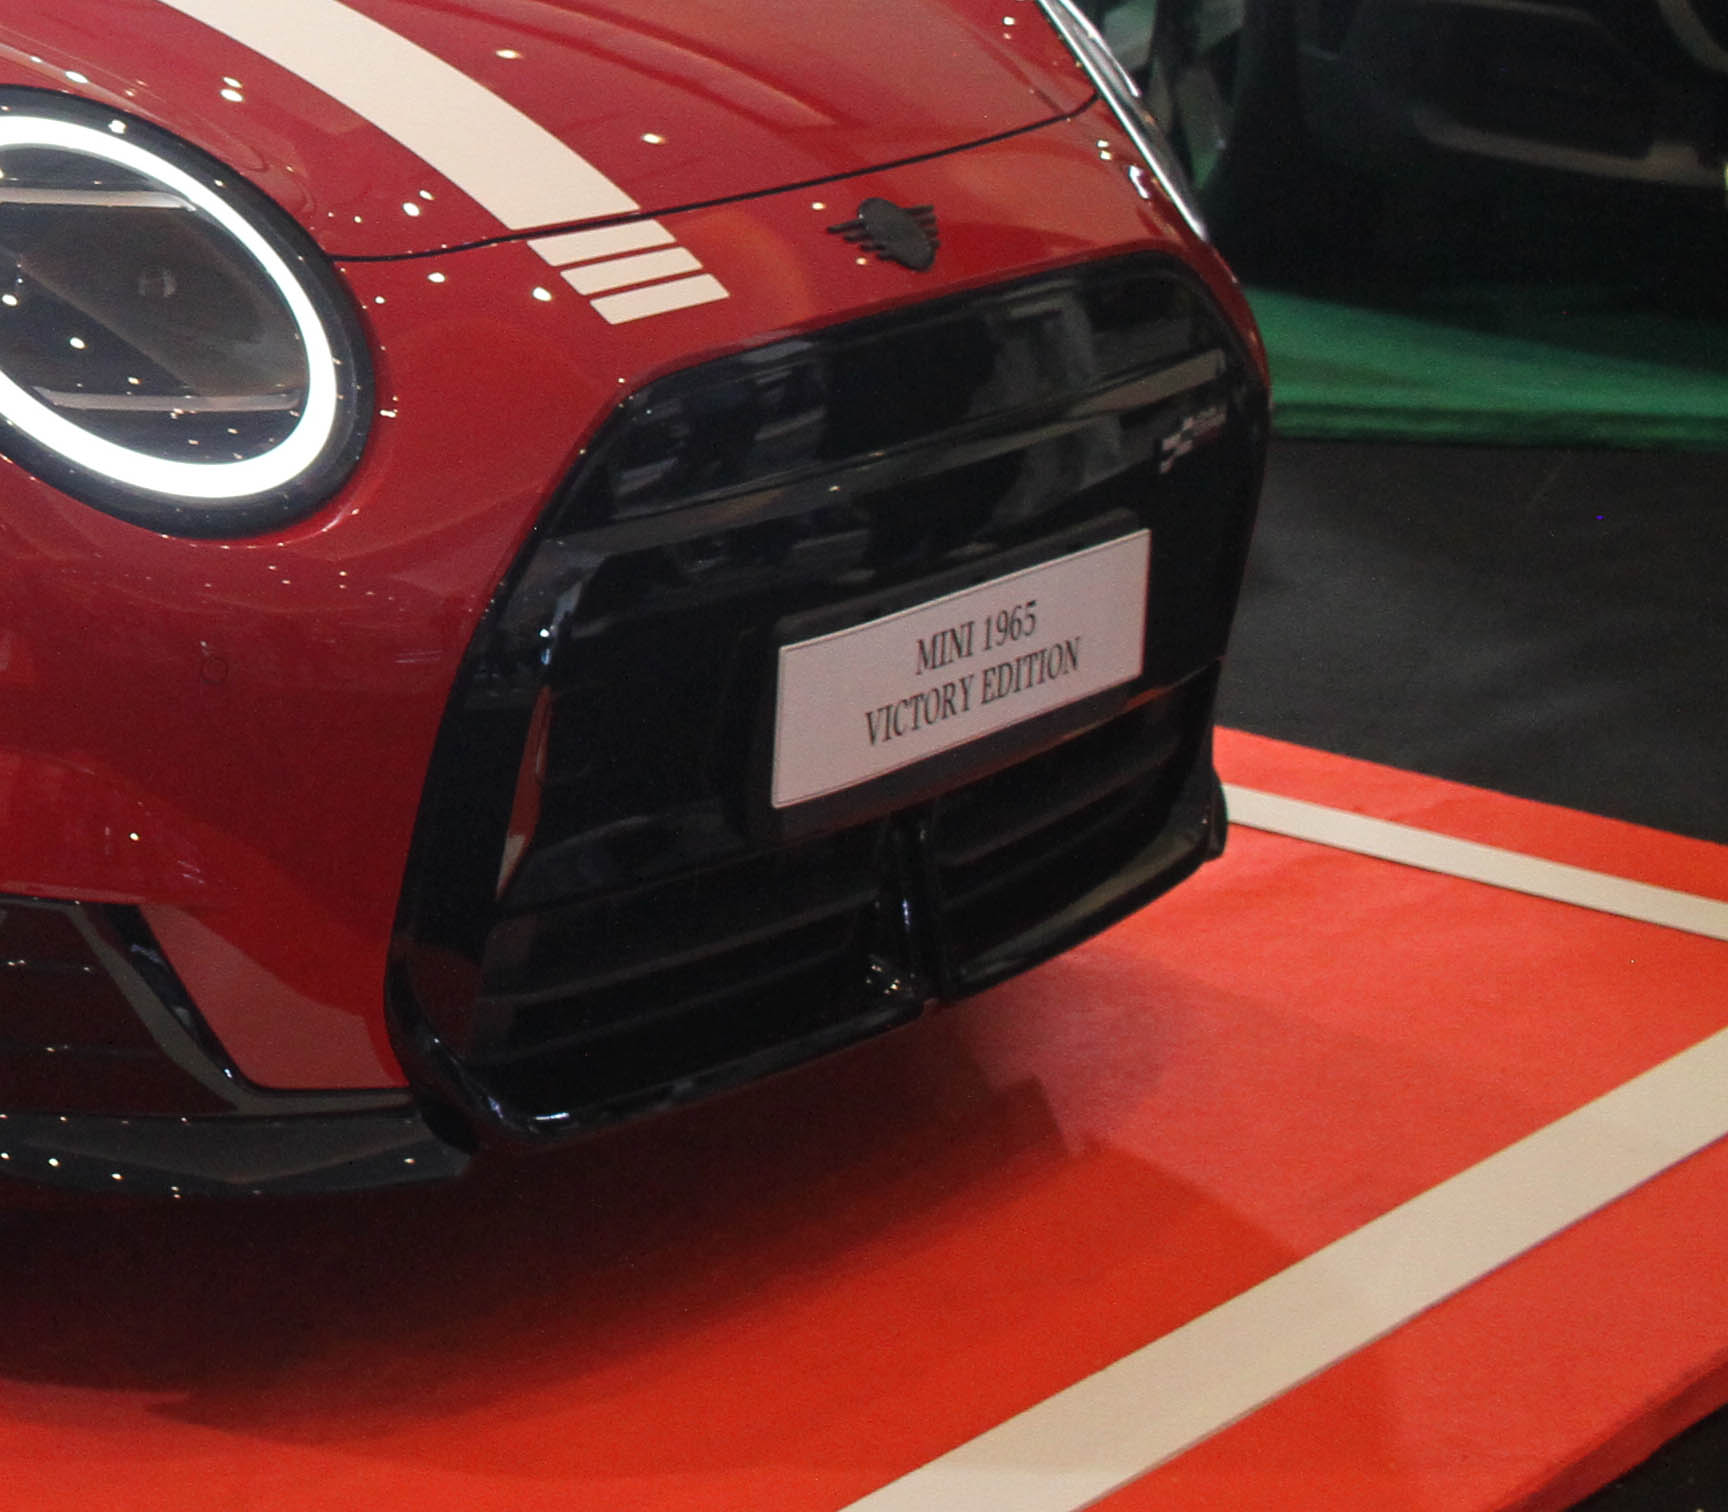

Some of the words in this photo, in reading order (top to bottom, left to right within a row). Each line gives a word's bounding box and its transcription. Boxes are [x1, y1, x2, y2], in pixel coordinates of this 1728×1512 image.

[916, 620, 975, 675] MINI
[983, 600, 1036, 652] 1965
[865, 674, 974, 746] VICTORY
[981, 637, 1080, 705] EDITION
